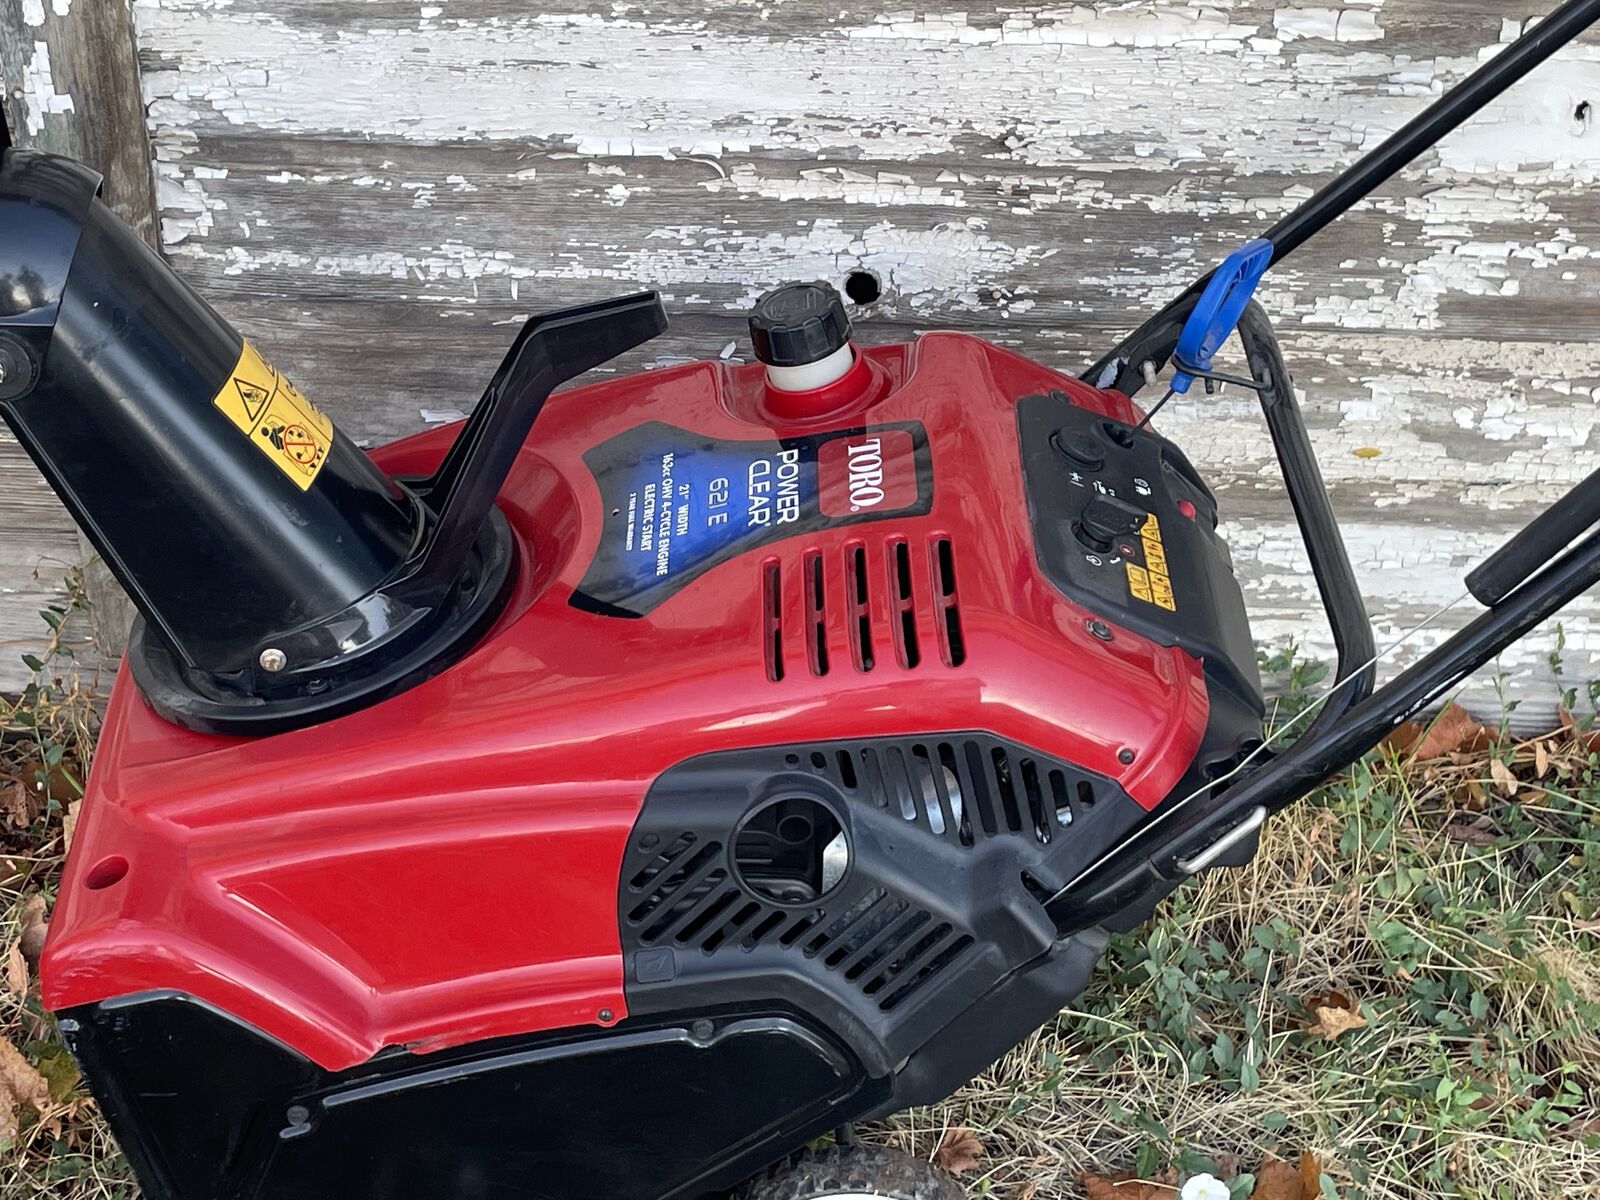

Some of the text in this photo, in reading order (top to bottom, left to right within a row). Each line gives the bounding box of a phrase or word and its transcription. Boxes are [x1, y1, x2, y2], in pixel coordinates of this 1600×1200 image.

[708, 477, 728, 526] 621 E
[748, 459, 771, 527] CLEAR
[777, 449, 799, 524] POWER
[848, 438, 884, 506] TORO
[640, 483, 656, 551] ELECTRIC START
[656, 452, 674, 576] 163cc OHV 4-CYCLE ENGINE
[677, 503, 689, 536] WIDTH
